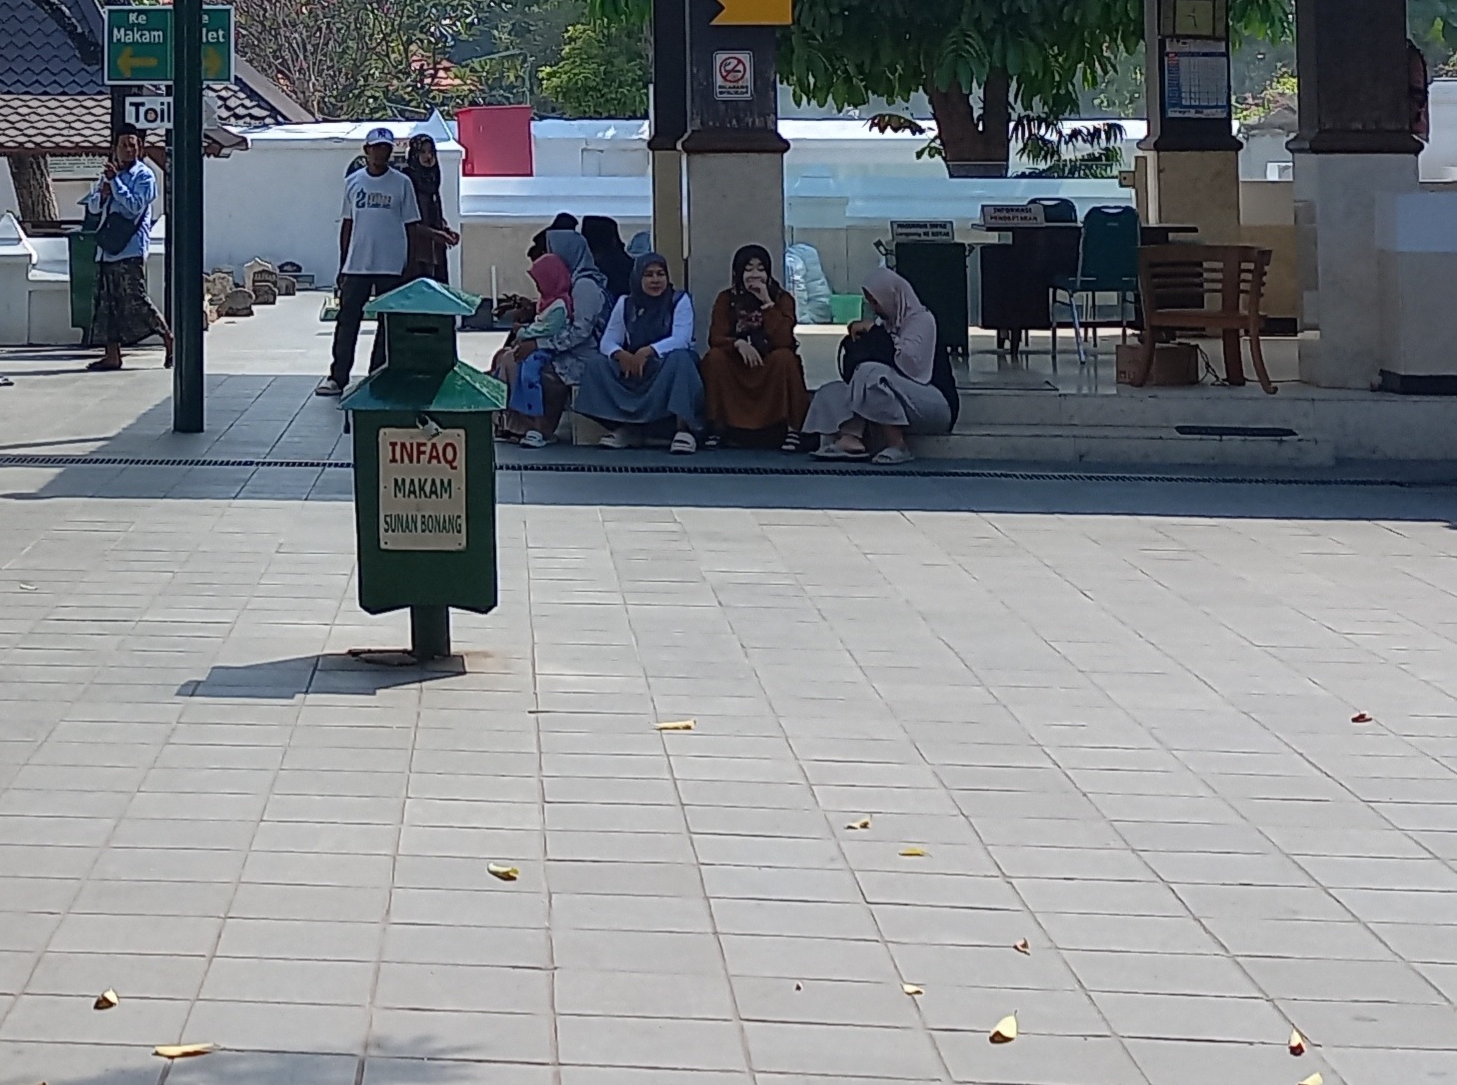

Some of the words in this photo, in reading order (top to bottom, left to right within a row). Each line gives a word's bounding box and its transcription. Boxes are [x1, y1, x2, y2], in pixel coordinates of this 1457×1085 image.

[128, 12, 147, 24] Ke
[112, 26, 163, 43] Makam
[389, 441, 458, 470] INFAQ
[393, 477, 453, 499] MAKAM
[383, 514, 419, 533] SUNAN
[420, 514, 462, 534] BONANG
